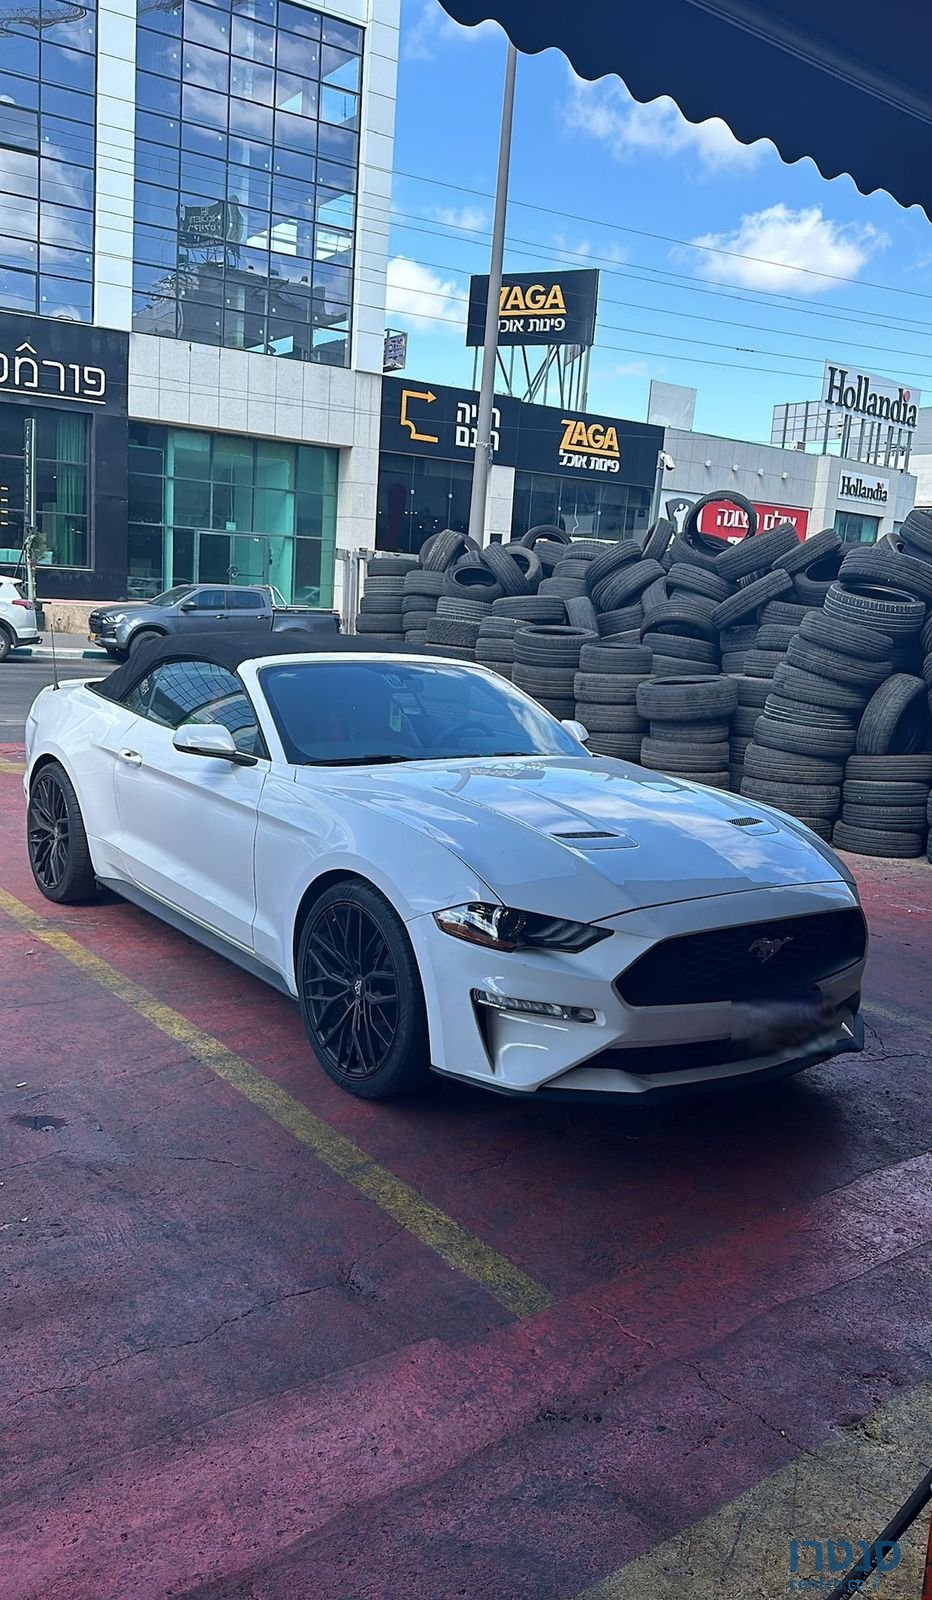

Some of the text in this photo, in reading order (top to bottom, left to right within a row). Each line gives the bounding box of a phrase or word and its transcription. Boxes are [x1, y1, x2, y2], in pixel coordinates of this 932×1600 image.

[498, 317, 566, 333] פינות אוכ
[825, 366, 918, 428] Hollandia
[456, 402, 501, 429] חיה
[559, 419, 621, 458] ZAGA
[559, 449, 620, 474] פינות אוכל
[839, 475, 888, 502] Hollandia
